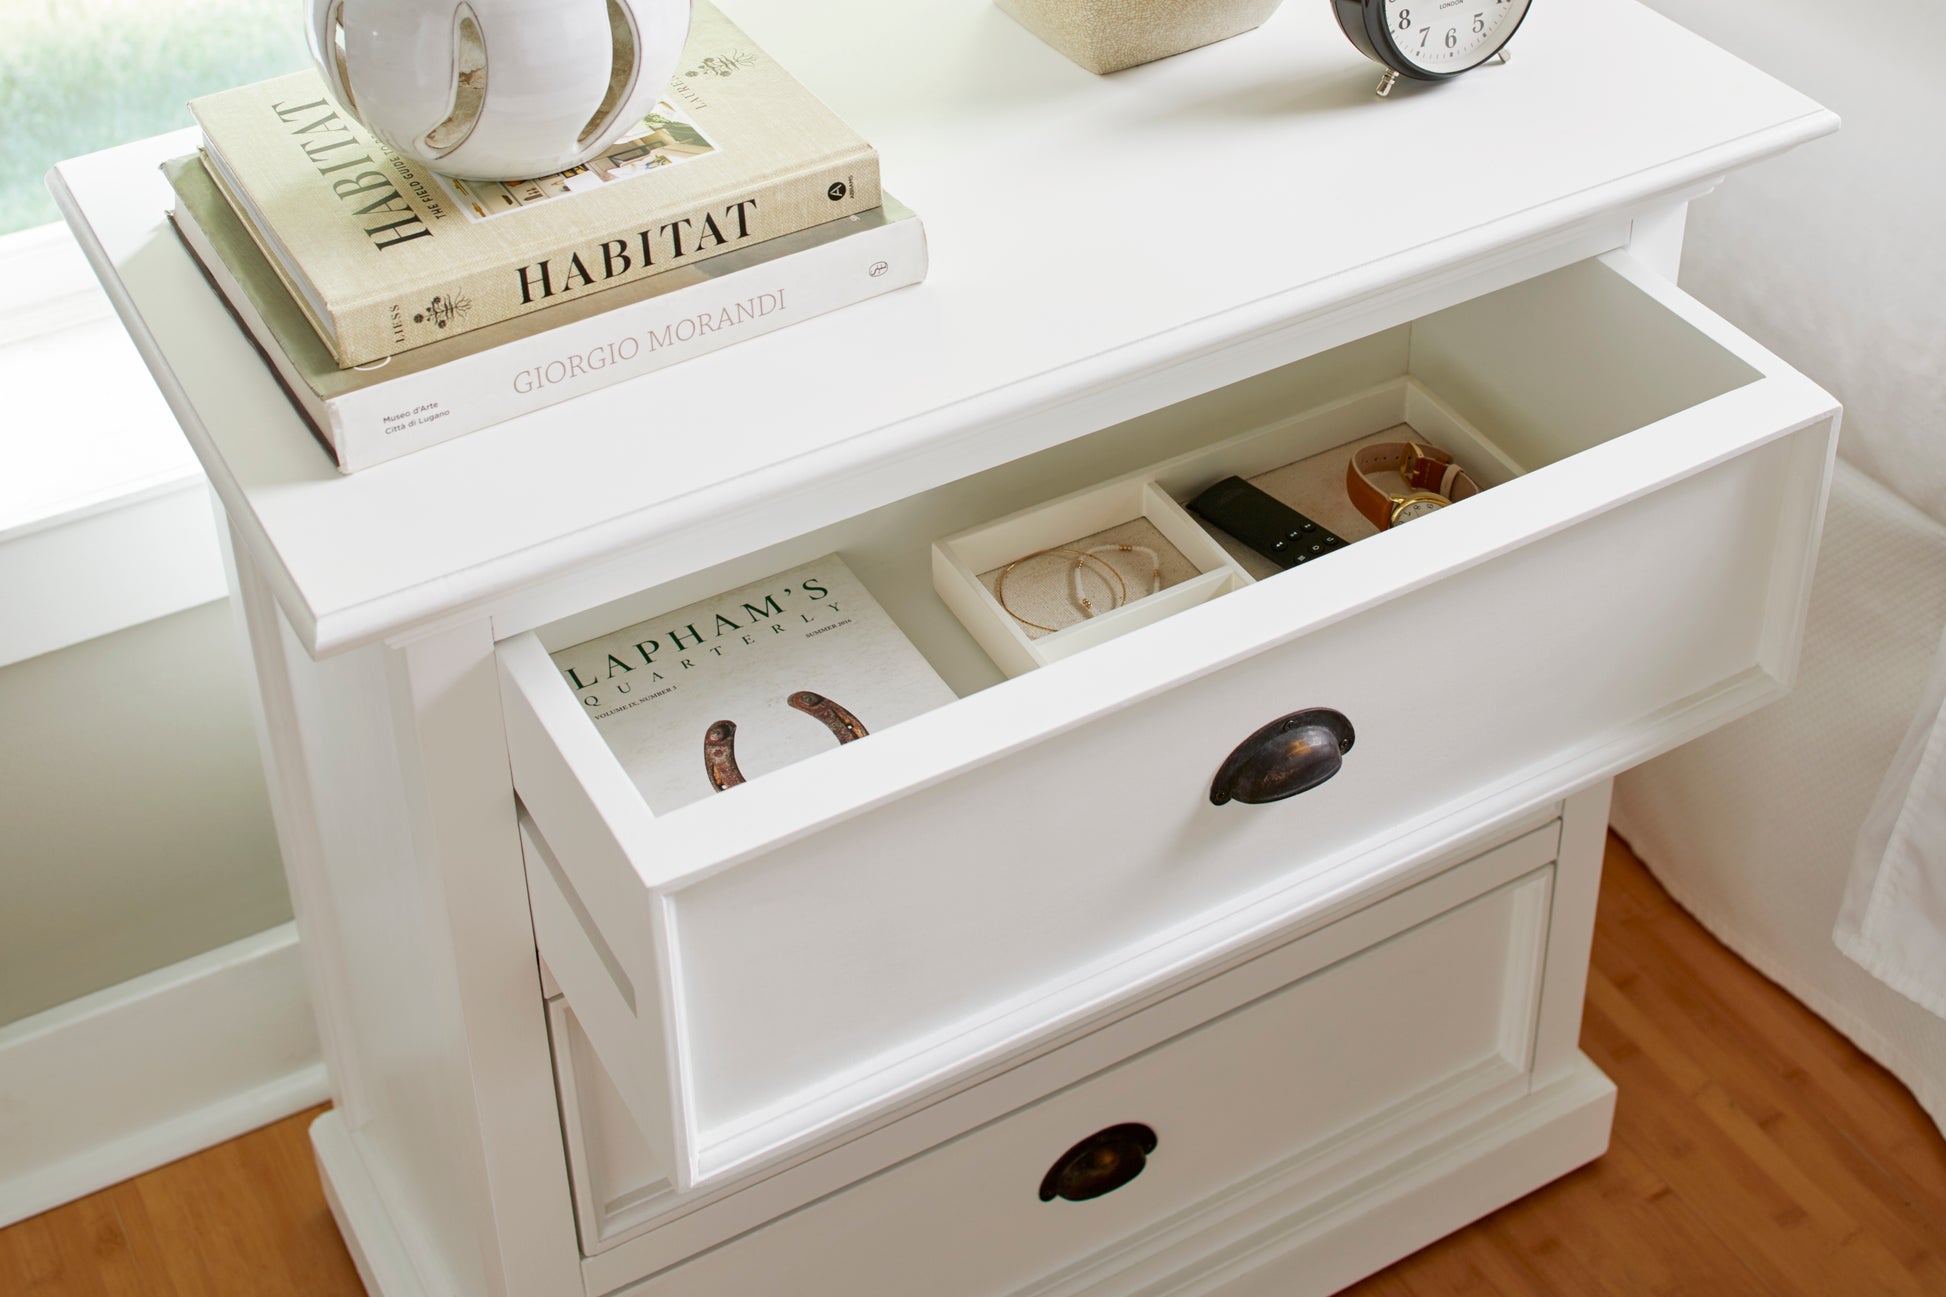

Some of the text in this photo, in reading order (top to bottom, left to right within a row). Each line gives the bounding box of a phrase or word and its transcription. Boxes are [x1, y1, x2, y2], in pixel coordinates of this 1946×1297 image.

[1399, 9, 1411, 30] 8
[1472, 12, 1484, 33] 5
[1419, 26, 1431, 48] 7
[1445, 28, 1457, 48] 6
[271, 97, 434, 252] HABITAT
[389, 156, 413, 180] GUIDE
[409, 180, 433, 203] FIELD
[427, 203, 447, 220] THE
[516, 199, 757, 304] HABITAT
[513, 289, 786, 395] GIORGIO MORANDI
[383, 401, 439, 424] Museo d'Arte
[408, 417, 417, 428] di
[418, 409, 451, 426] Lugano
[805, 623, 837, 638] SUMMER
[584, 602, 841, 707] QUARTERLY
[594, 704, 629, 720] VOLUME
[639, 687, 672, 704] NUMBER
